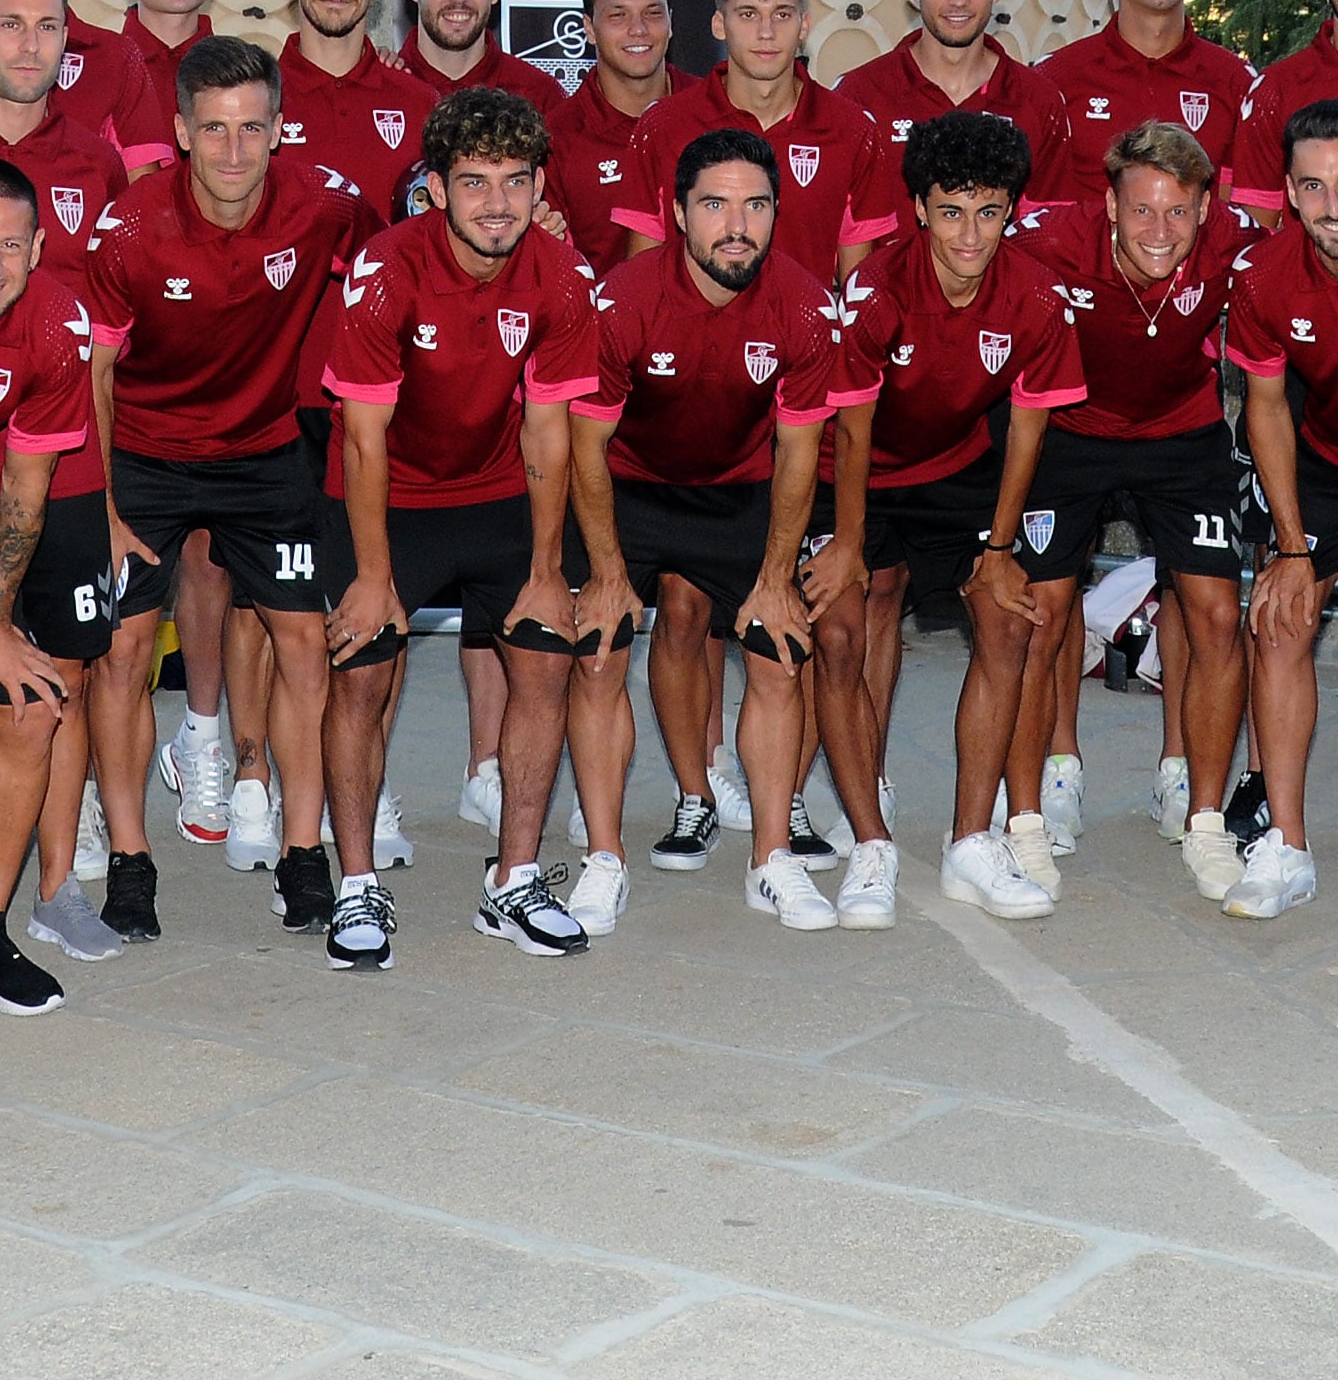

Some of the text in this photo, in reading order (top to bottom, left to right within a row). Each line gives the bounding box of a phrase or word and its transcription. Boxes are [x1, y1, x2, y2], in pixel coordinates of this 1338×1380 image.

[1192, 513, 1229, 548] 11
[275, 543, 315, 580] 14
[73, 584, 97, 622] 6
